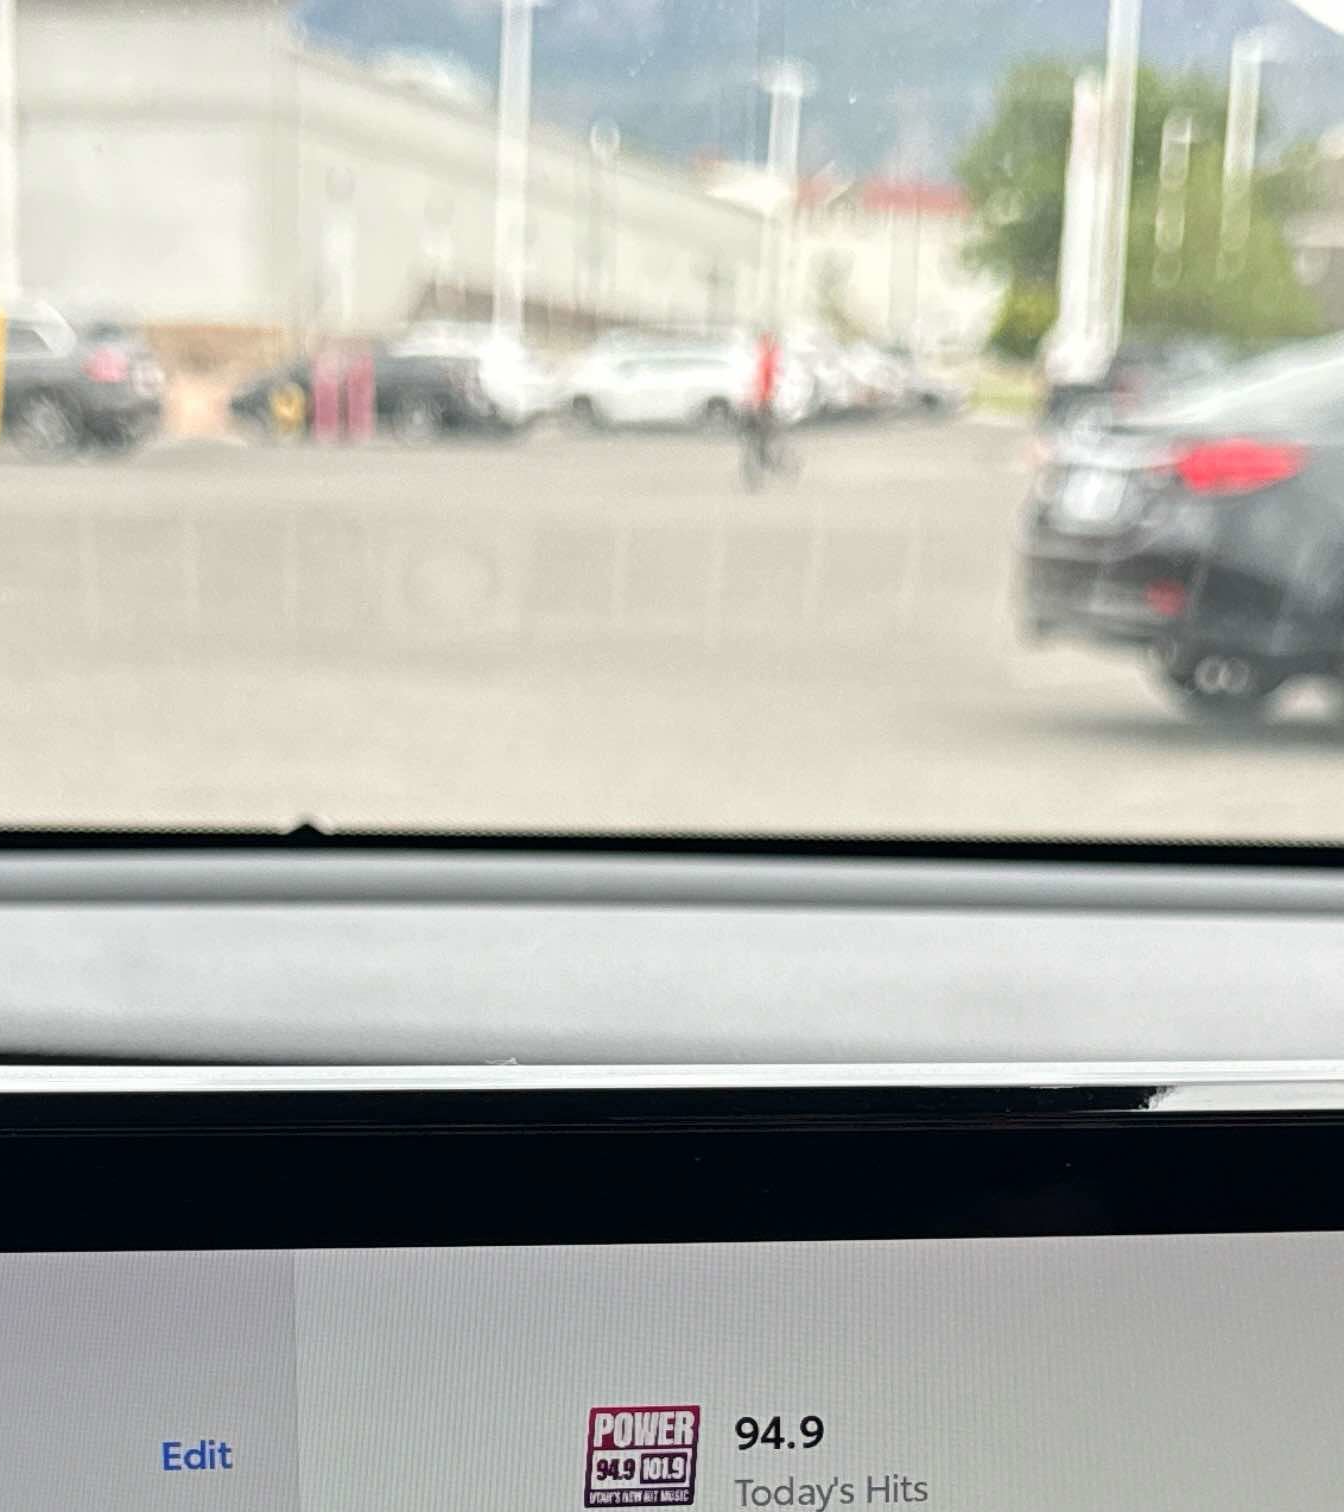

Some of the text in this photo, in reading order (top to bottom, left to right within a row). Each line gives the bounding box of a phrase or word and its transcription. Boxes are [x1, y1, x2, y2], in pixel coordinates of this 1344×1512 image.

[593, 1410, 696, 1448] POWER
[735, 1415, 825, 1451] 94.9
[162, 1439, 233, 1471] Edit
[596, 1456, 686, 1481] 94.9 101.9
[867, 1473, 929, 1503] Hits
